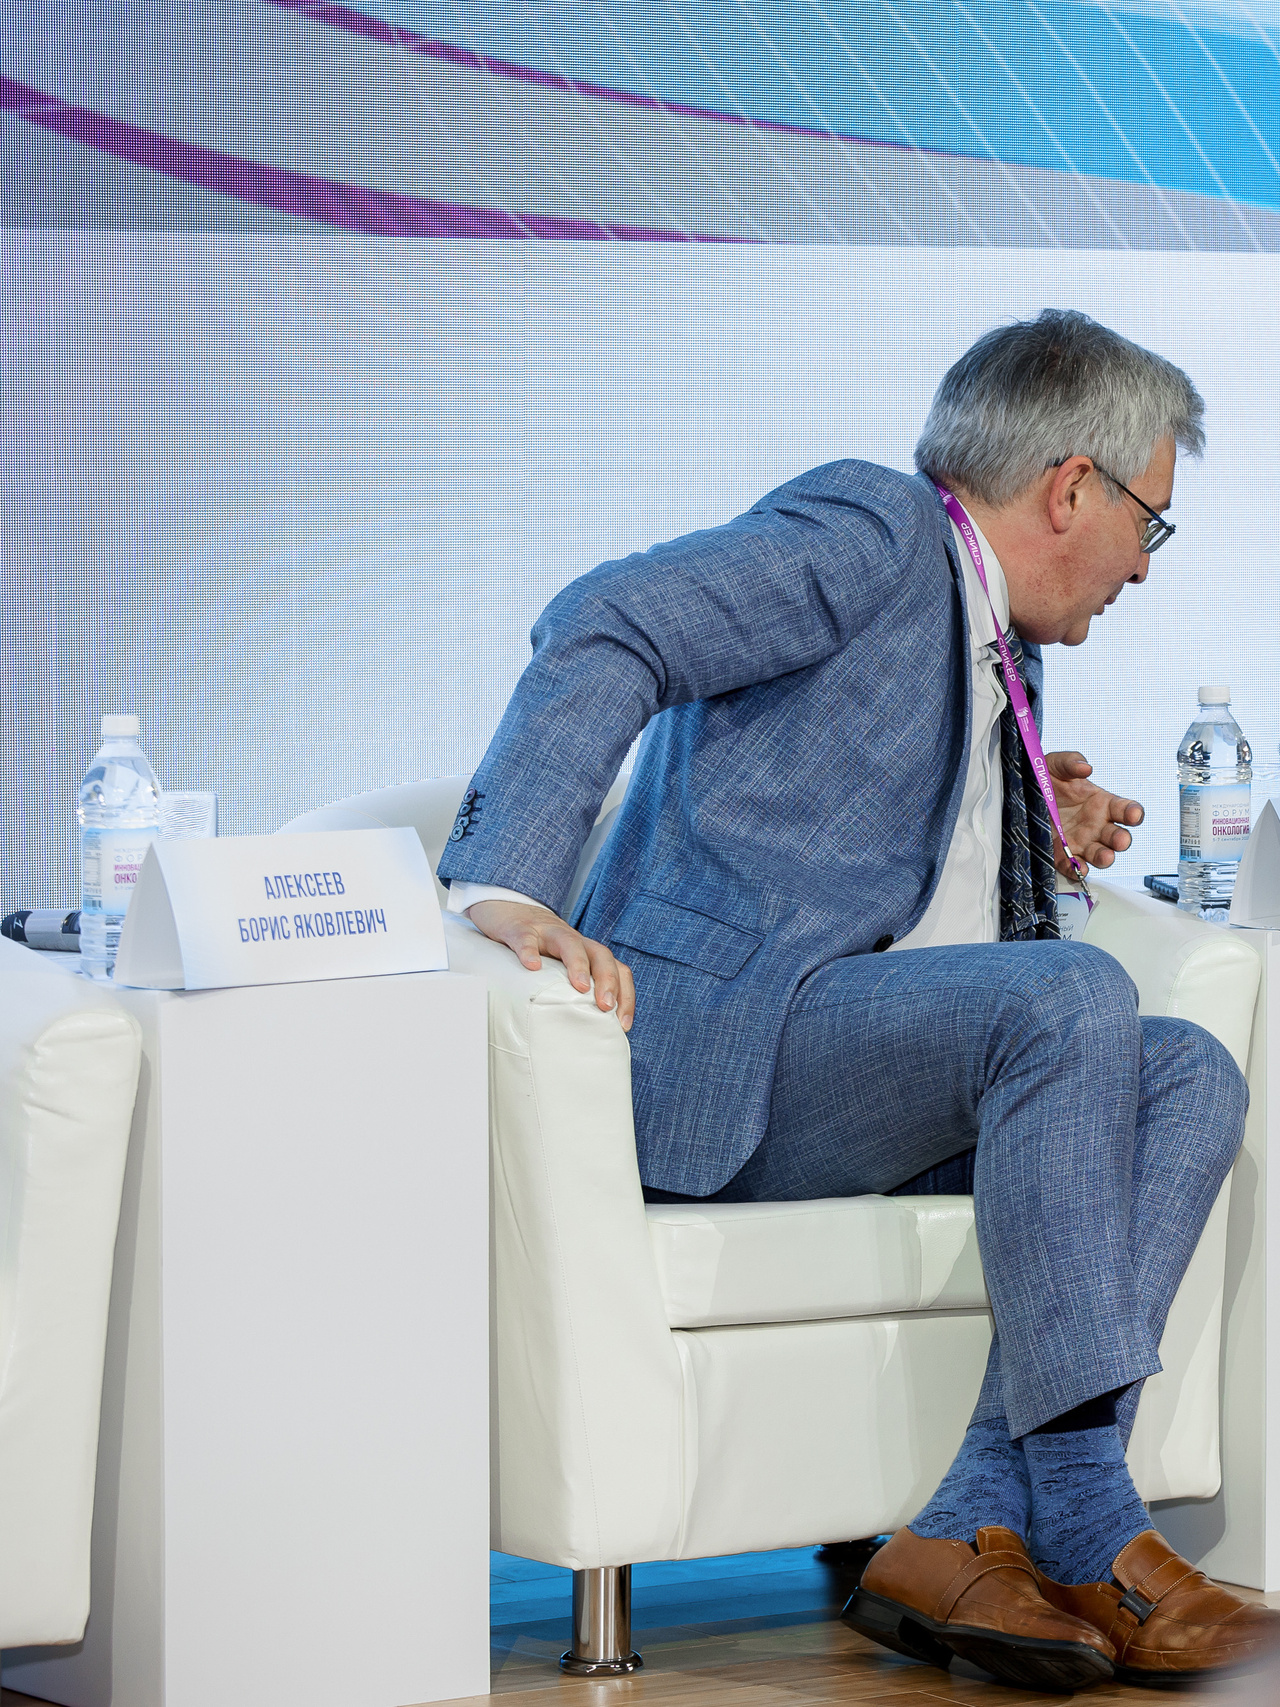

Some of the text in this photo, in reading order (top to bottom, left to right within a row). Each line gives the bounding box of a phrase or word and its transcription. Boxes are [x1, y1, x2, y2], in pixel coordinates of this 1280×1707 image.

[961, 522, 982, 566] СПИКЕР
[997, 637, 1017, 682] СПИКЕР
[1034, 757, 1054, 802] СПИКЕР
[1212, 825, 1250, 836] ОНКОЛОГИЯ
[264, 871, 346, 900] АЛЕКСЕЕВ
[238, 908, 388, 943] БОРИС ЯКОВЛЕВИЧ
